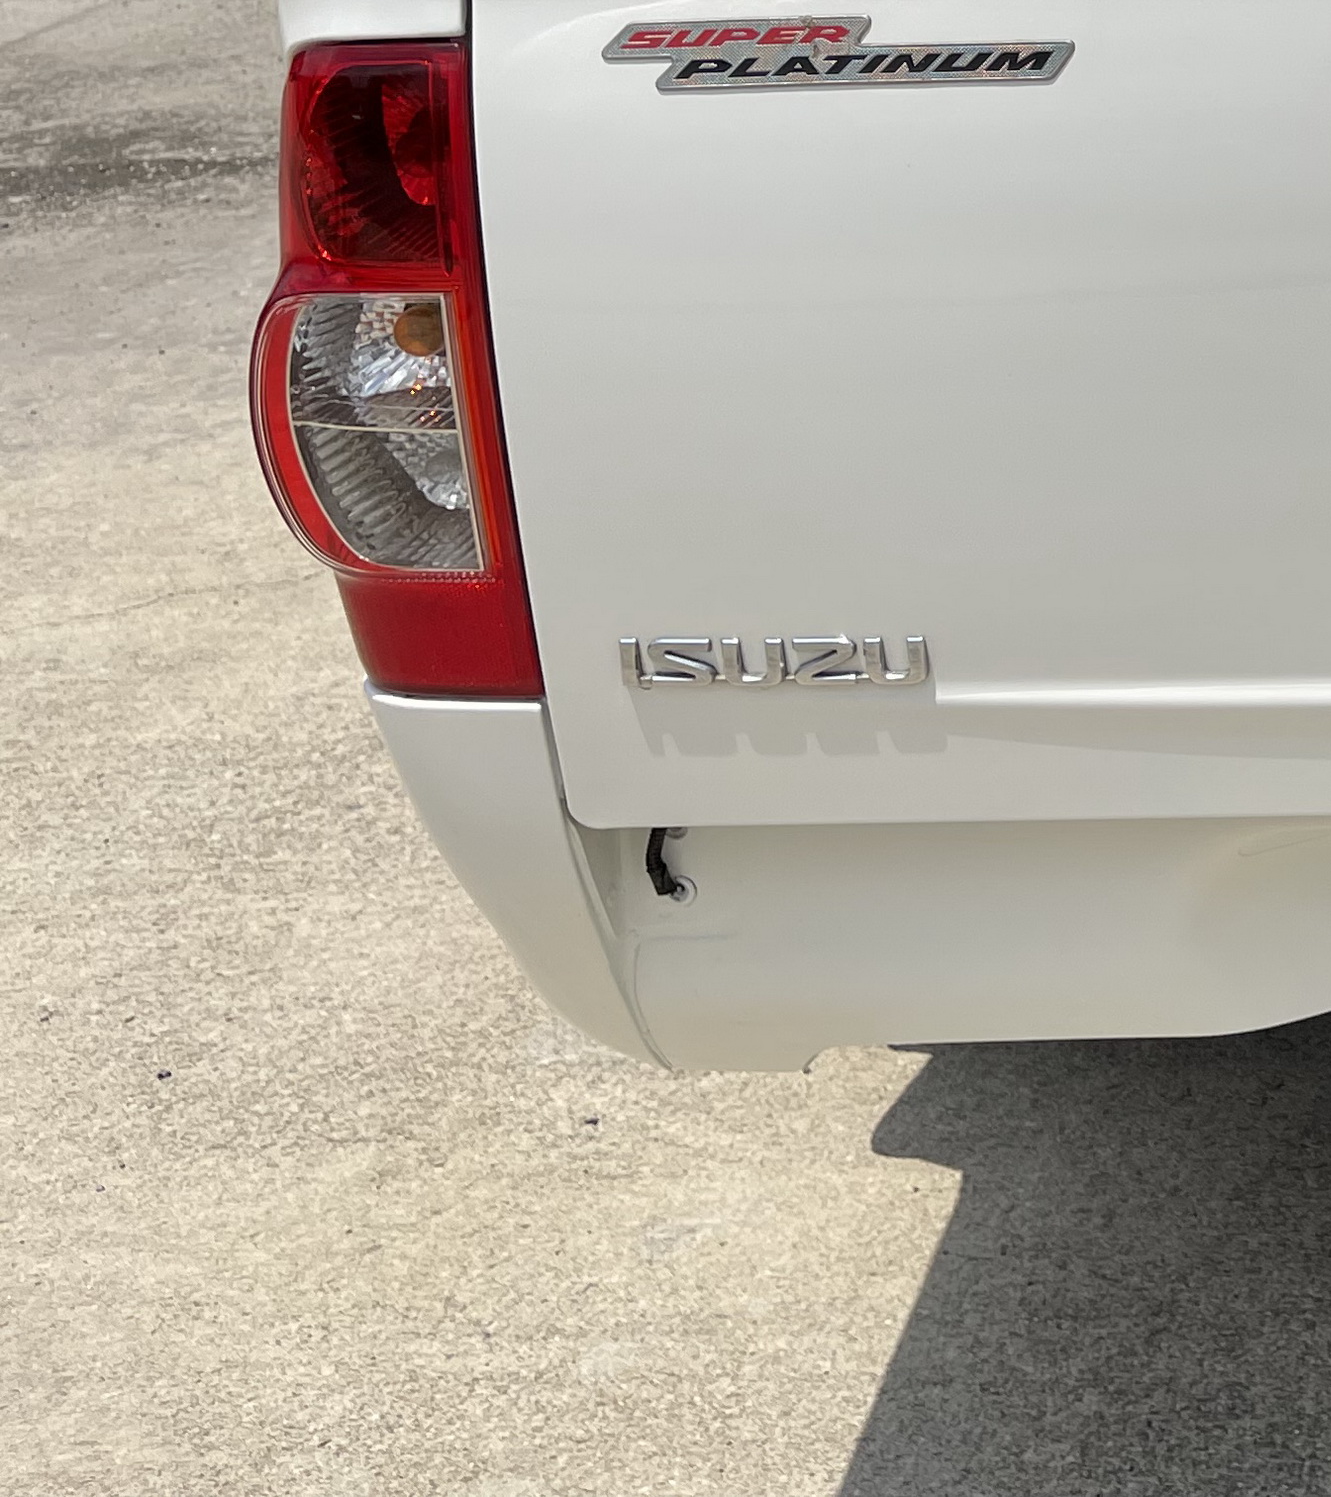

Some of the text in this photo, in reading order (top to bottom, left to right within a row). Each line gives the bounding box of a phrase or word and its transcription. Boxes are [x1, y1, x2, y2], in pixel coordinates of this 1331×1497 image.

[620, 25, 851, 50] SUPER
[673, 50, 1055, 80] PLATINUM
[619, 634, 929, 690] ISUZU
